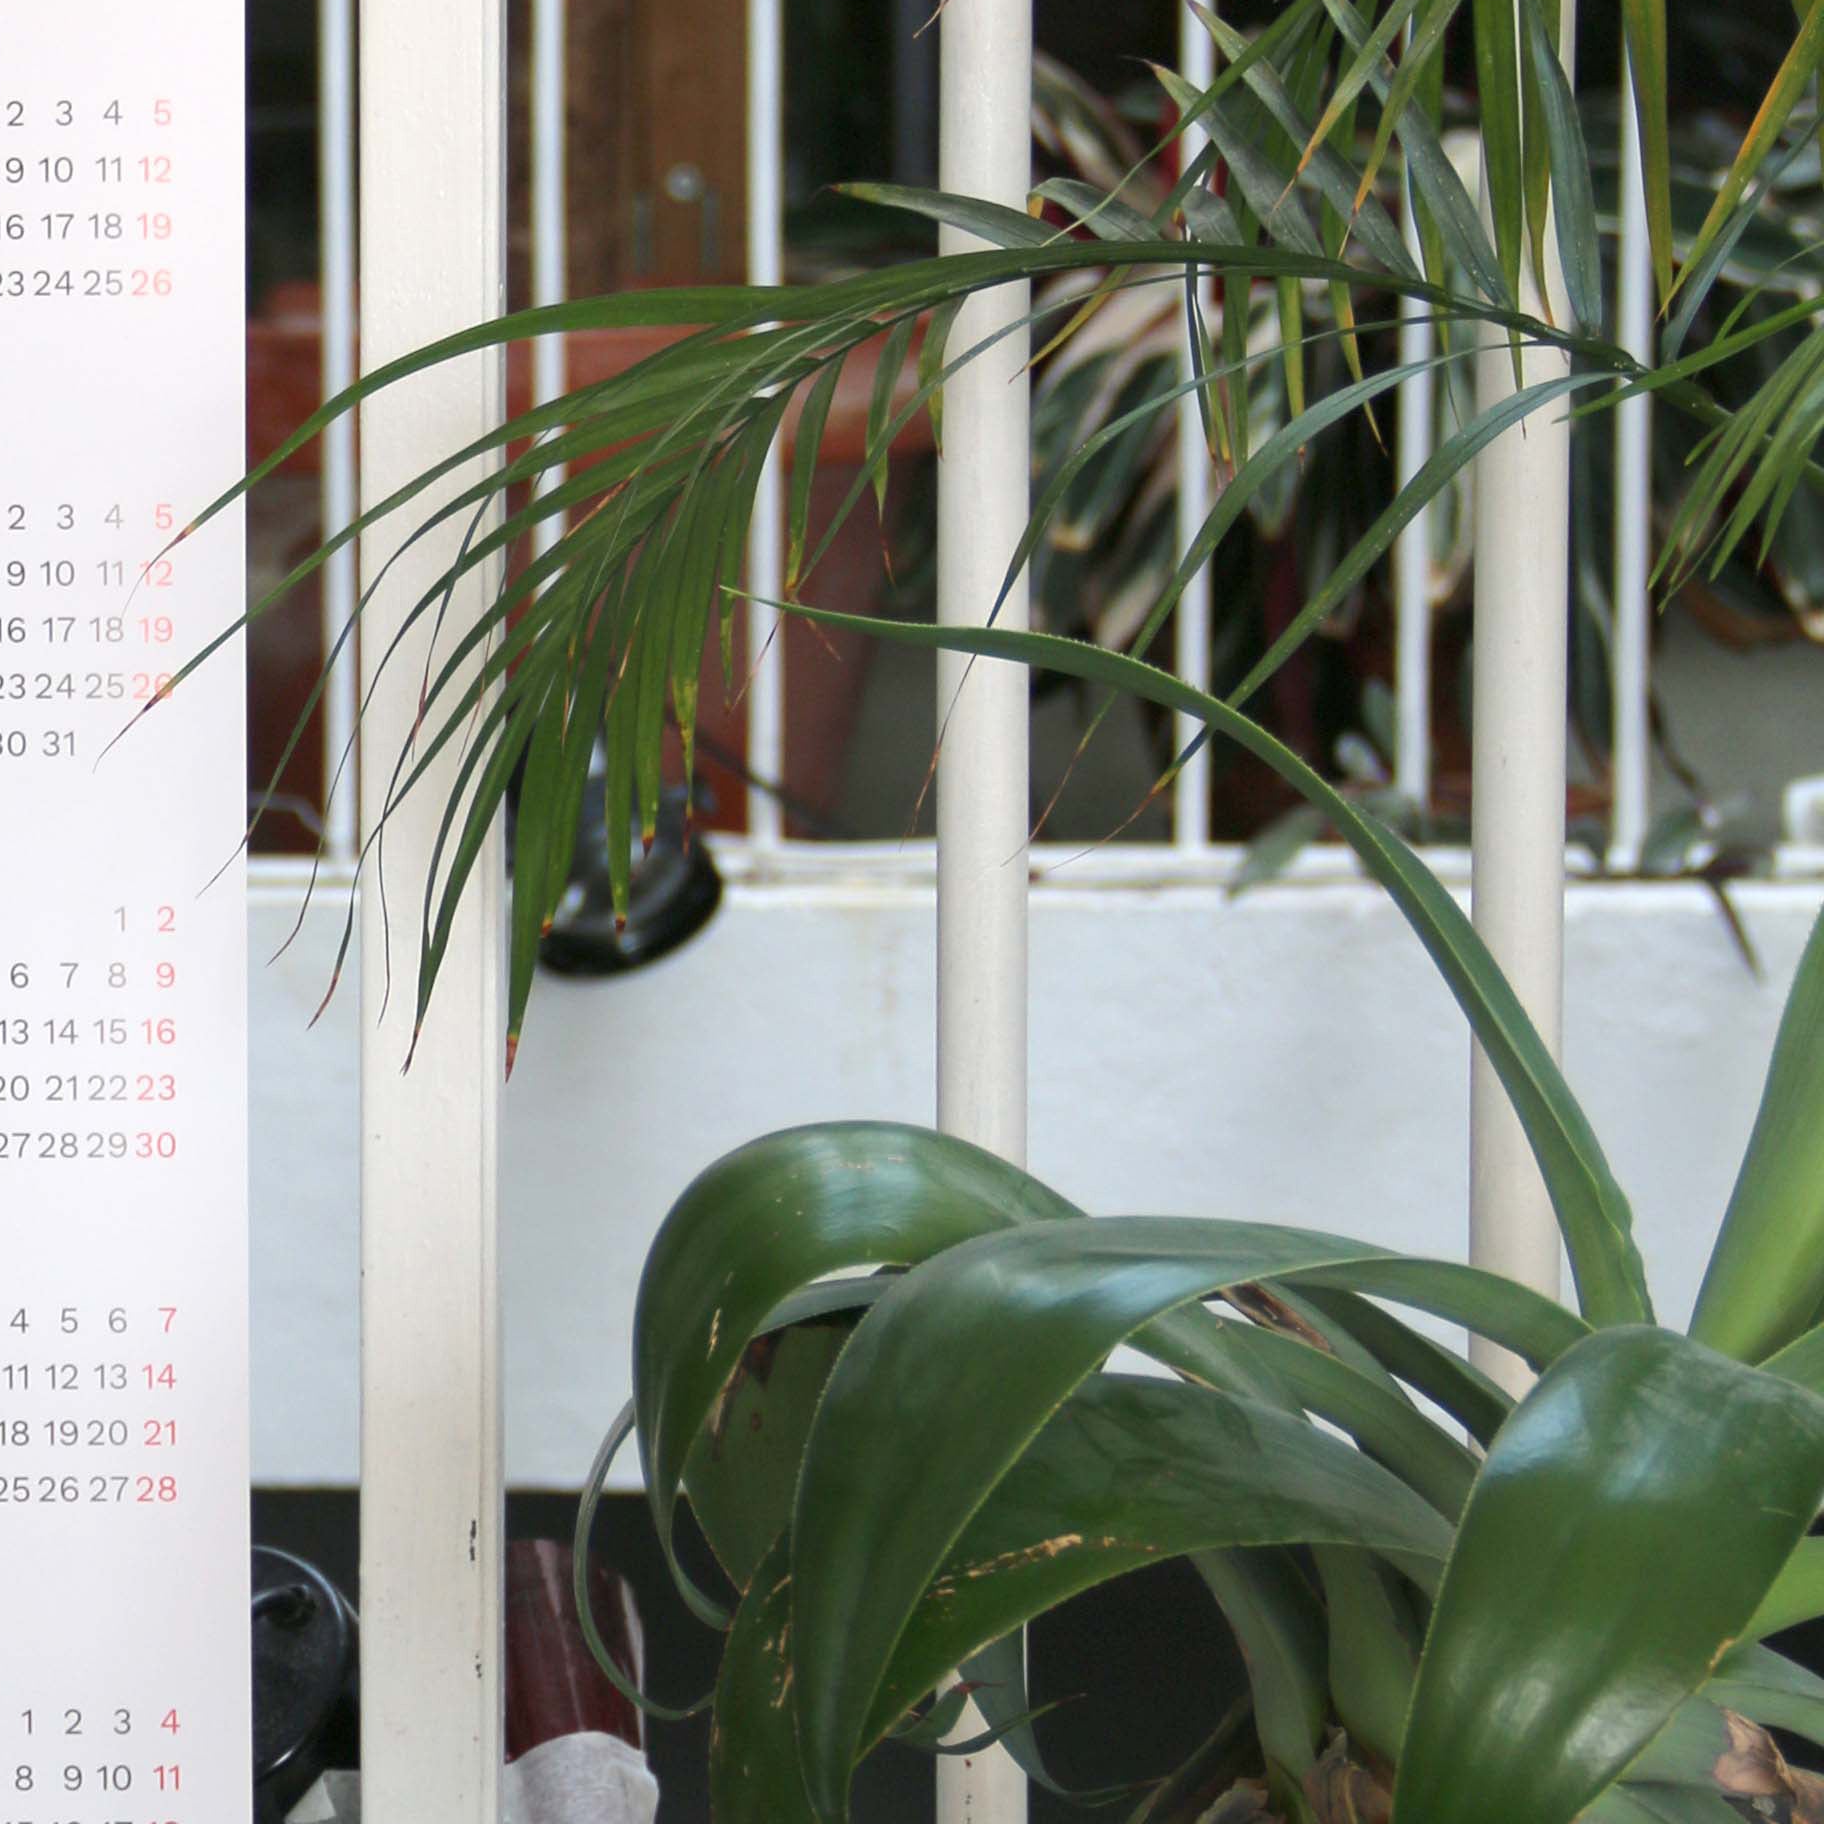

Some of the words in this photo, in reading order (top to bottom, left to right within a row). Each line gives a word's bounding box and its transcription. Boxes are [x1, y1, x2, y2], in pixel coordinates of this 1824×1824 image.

[7, 101, 24, 126] 2
[56, 100, 73, 126] 3
[103, 100, 123, 125] 4
[154, 99, 172, 126] 5
[41, 214, 74, 239] 17
[88, 213, 122, 239] 18
[137, 213, 172, 240] 19
[8, 504, 25, 530] 2
[57, 504, 74, 530] 3
[104, 504, 124, 529] 4
[155, 504, 173, 530] 5
[7, 561, 25, 586] 9
[40, 560, 74, 586] 10
[97, 560, 123, 586] 11
[140, 560, 173, 586] 12
[43, 731, 74, 756] 31
[114, 906, 125, 932] 1
[157, 906, 176, 932] 2
[44, 1019, 78, 1044] 14
[93, 1019, 127, 1044] 15
[141, 1019, 176, 1045] 16
[38, 1133, 78, 1158] 28
[86, 1132, 127, 1158] 29
[136, 1132, 176, 1158] 30
[10, 1308, 29, 1333] 4
[61, 1308, 78, 1333] 5
[109, 1308, 127, 1333] 6
[158, 1307, 177, 1333] 7
[44, 1420, 78, 1446] 19
[87, 1420, 128, 1446] 20
[144, 1420, 175, 1446] 21
[21, 1709, 32, 1735] 1
[64, 1709, 82, 1734] 2
[114, 1709, 131, 1735] 3
[161, 1709, 180, 1734] 4
[15, 1765, 33, 1791] 8
[64, 1765, 82, 1791] 9
[97, 1765, 131, 1791] 10
[154, 1765, 179, 1790] 11
